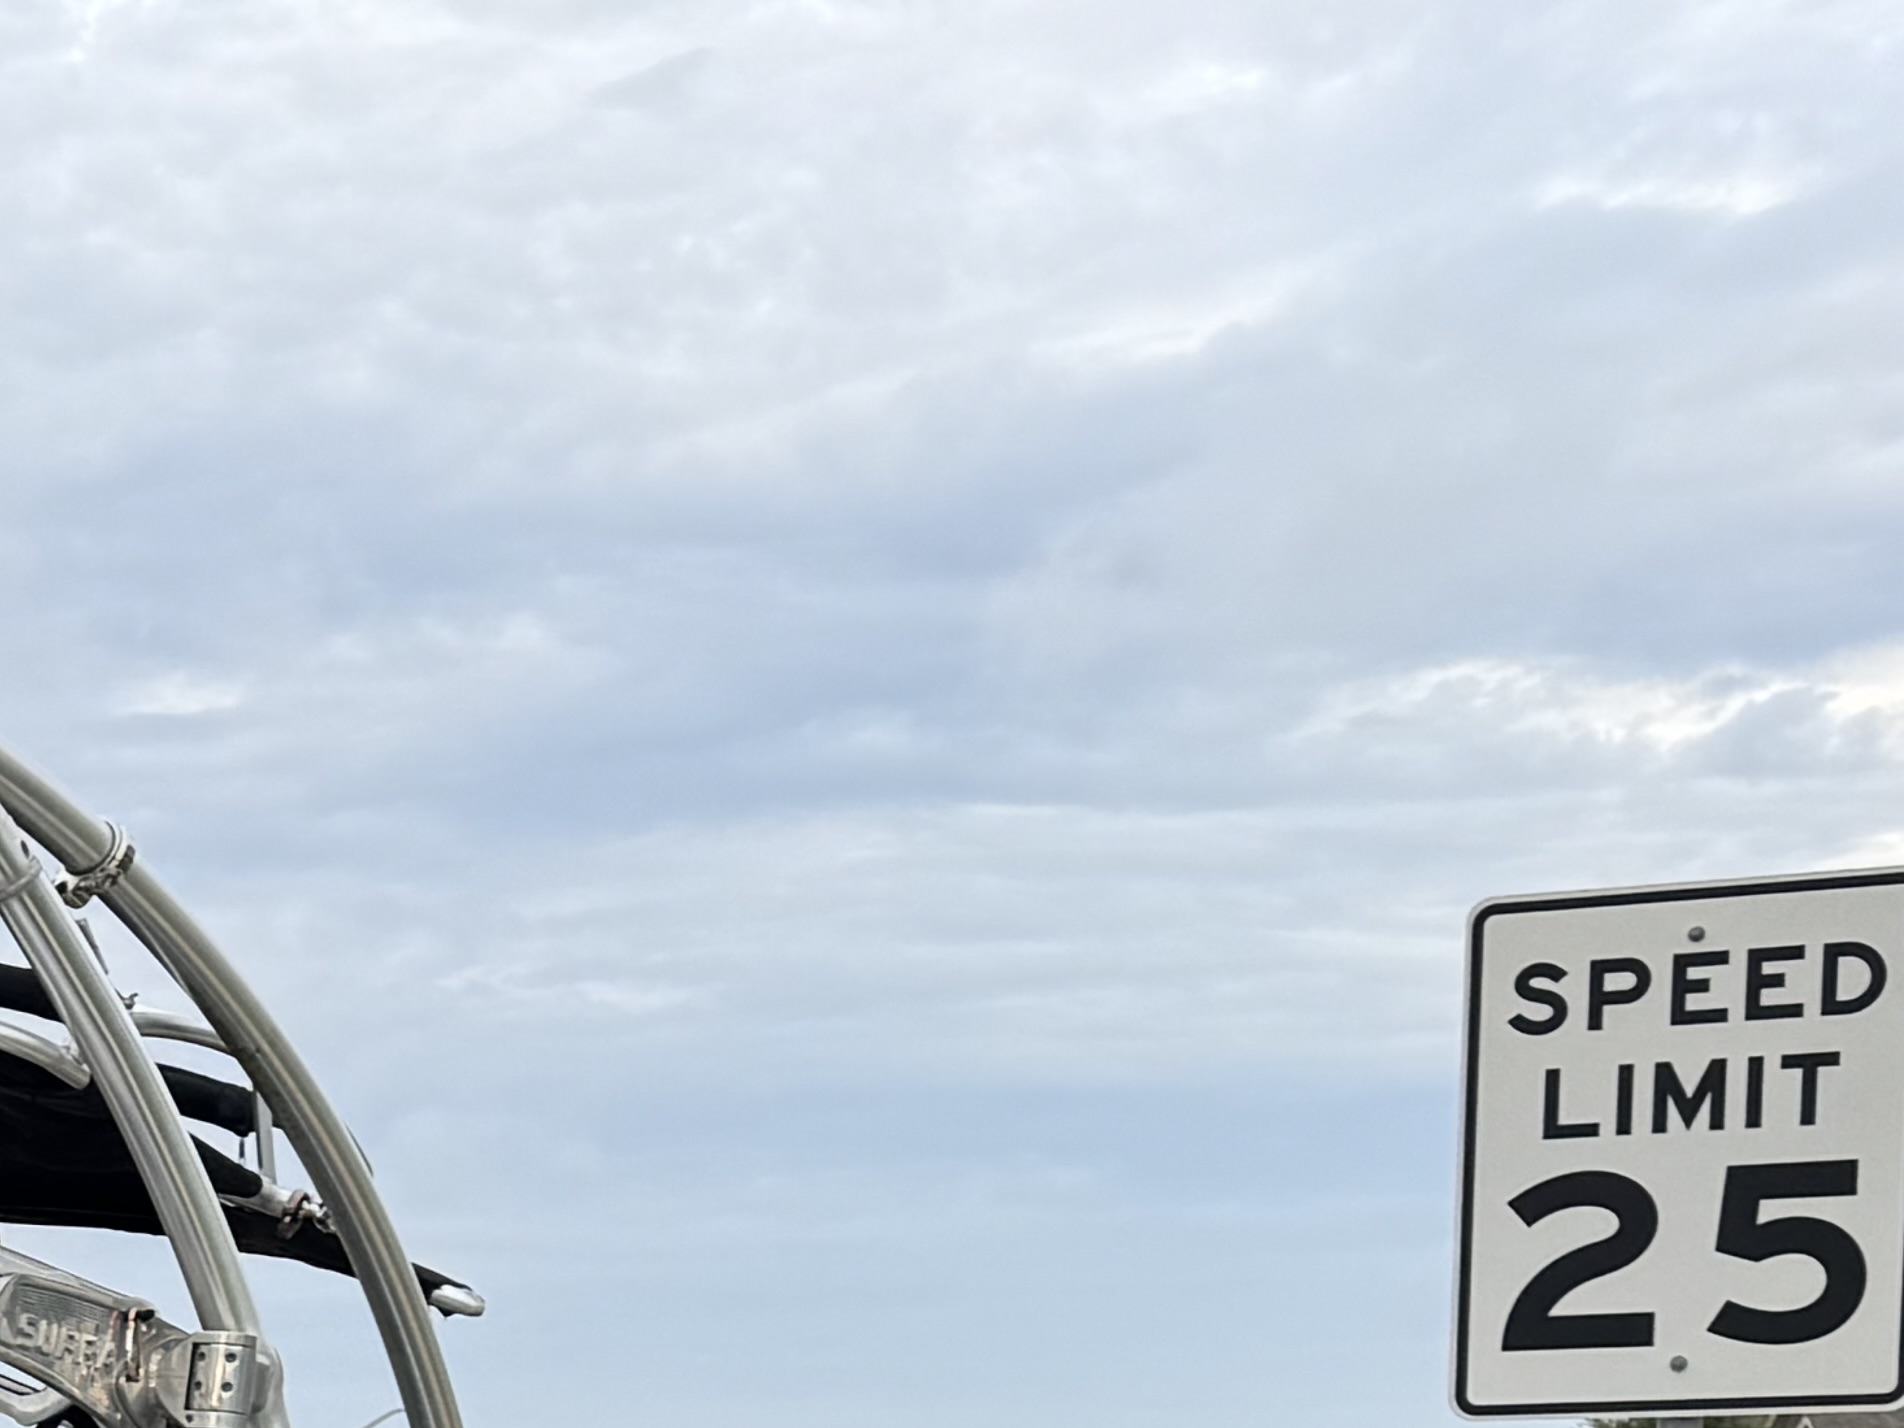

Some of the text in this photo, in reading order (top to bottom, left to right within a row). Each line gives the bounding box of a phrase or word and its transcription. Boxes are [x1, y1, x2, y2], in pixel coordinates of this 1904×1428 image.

[1507, 941, 1888, 1036] SPEED
[1542, 1051, 1841, 1139] LIMIT
[1501, 1159, 1867, 1351] 25
